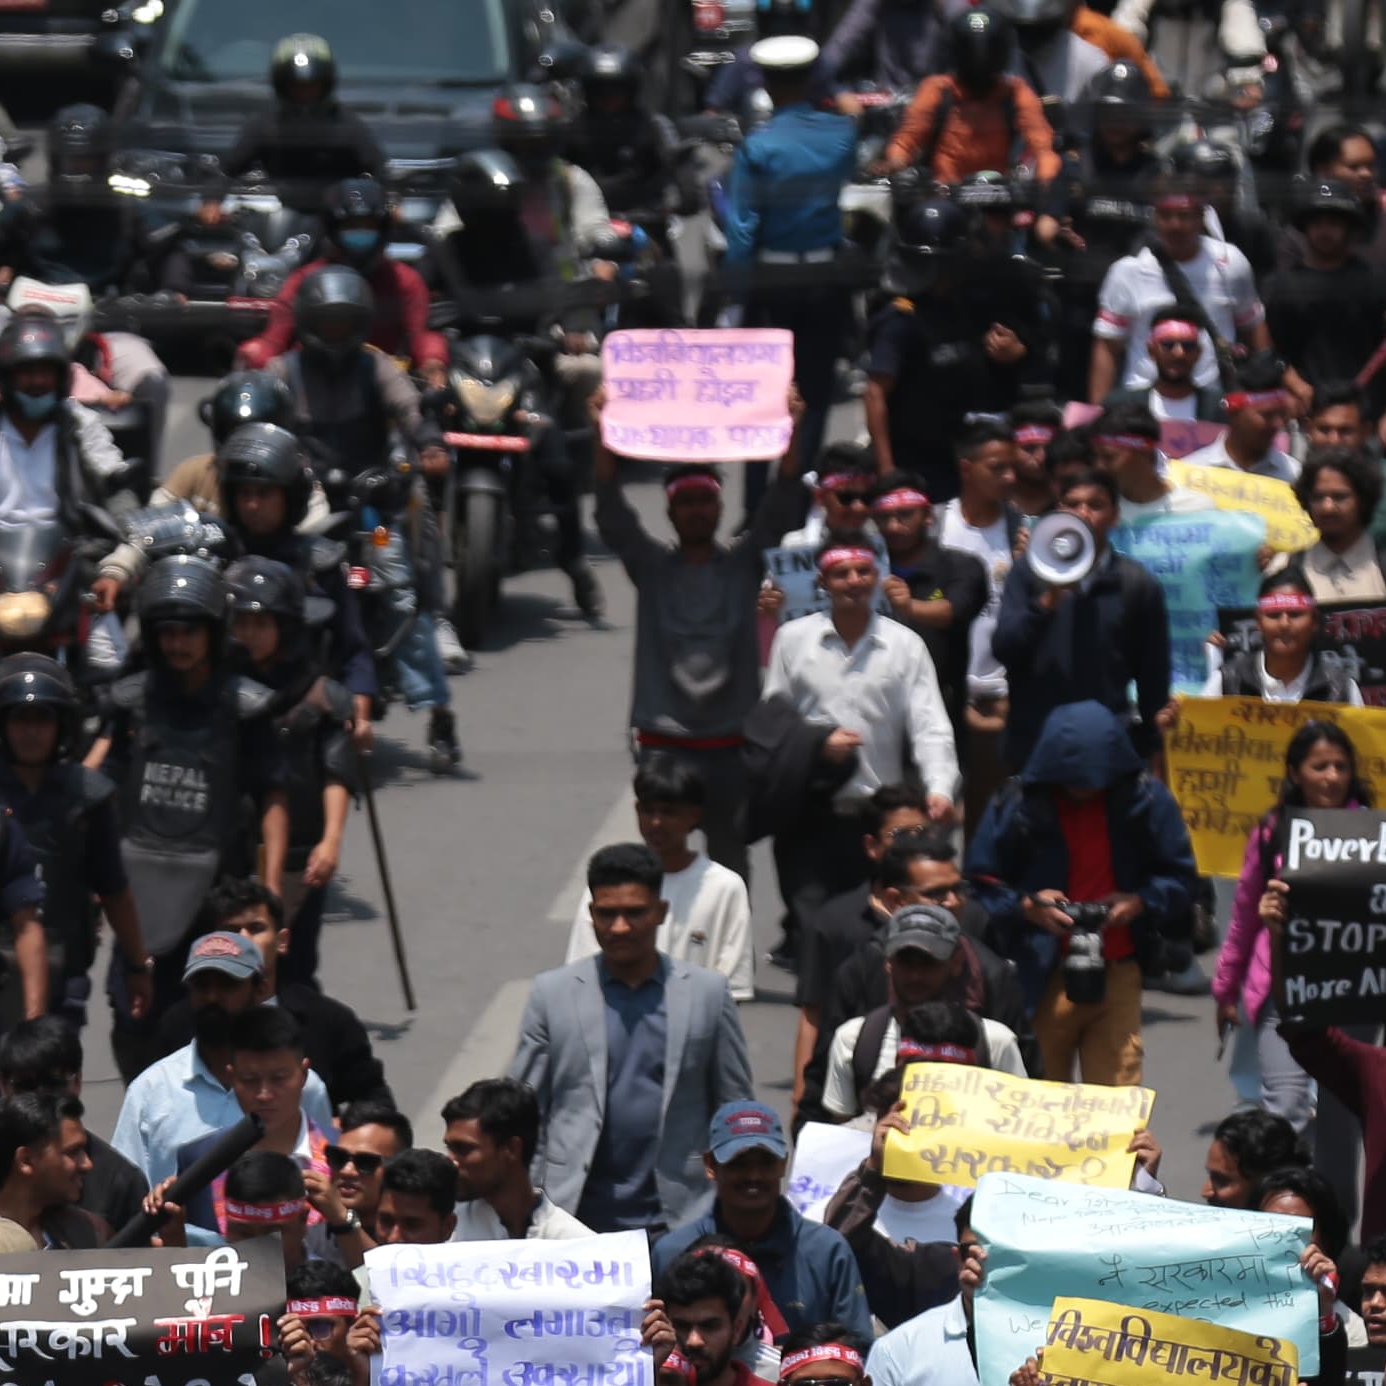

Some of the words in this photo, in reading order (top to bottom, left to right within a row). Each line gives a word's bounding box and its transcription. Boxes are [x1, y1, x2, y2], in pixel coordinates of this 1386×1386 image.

[144, 762, 210, 790] NEPAL
[141, 784, 210, 811] POLICE
[1284, 972, 1354, 1006] More
[1009, 1316, 1043, 1336] We
[1261, 1290, 1295, 1310] this
